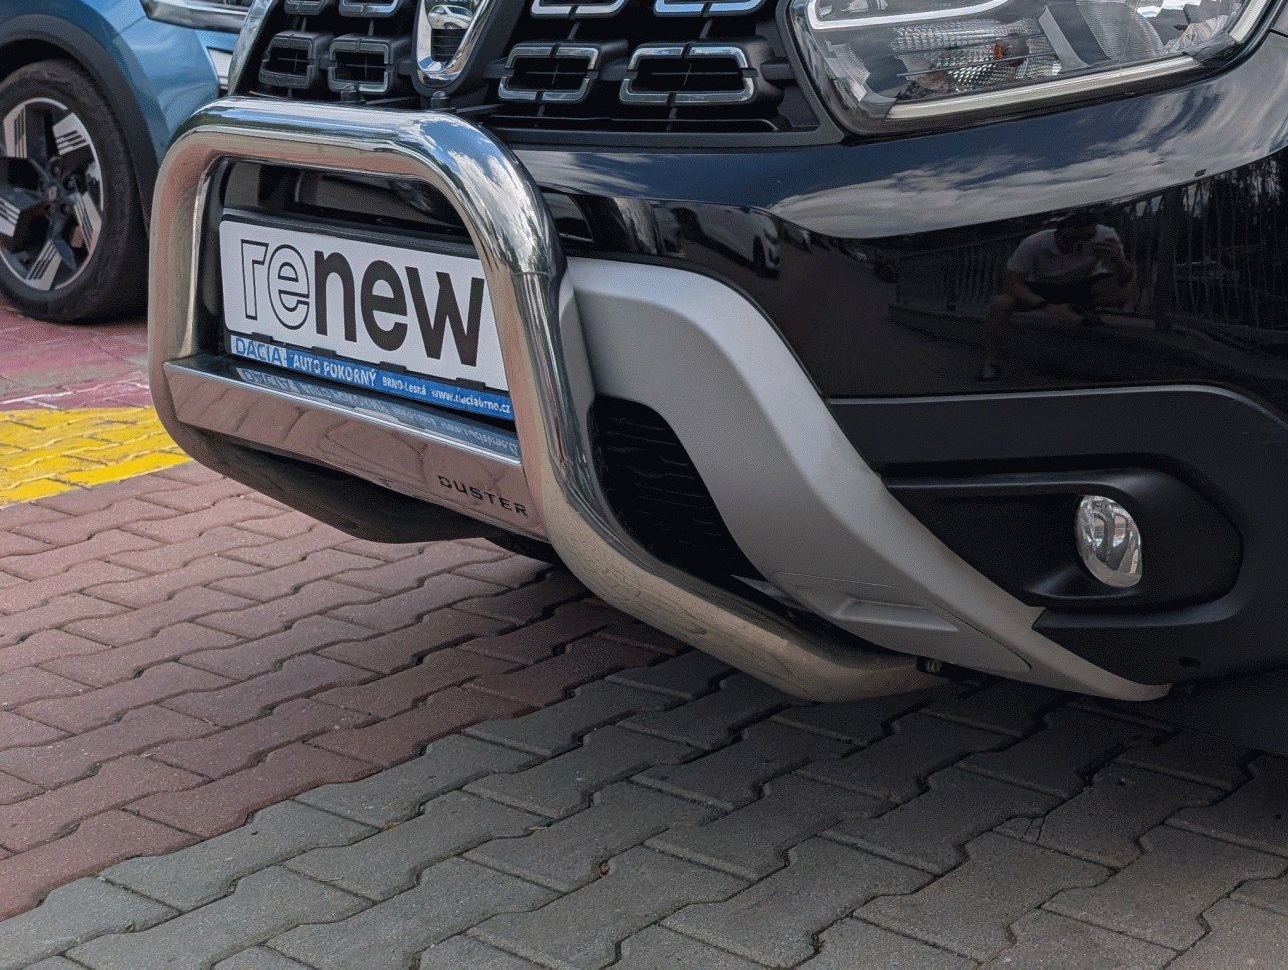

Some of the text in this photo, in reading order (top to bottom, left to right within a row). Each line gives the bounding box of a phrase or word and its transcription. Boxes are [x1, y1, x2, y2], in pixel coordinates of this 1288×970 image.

[240, 238, 485, 367] renew
[235, 336, 283, 365] DACIA
[293, 354, 321, 373] AUTO
[324, 360, 377, 387] POKORNÝ
[438, 475, 529, 518] DUSTER
